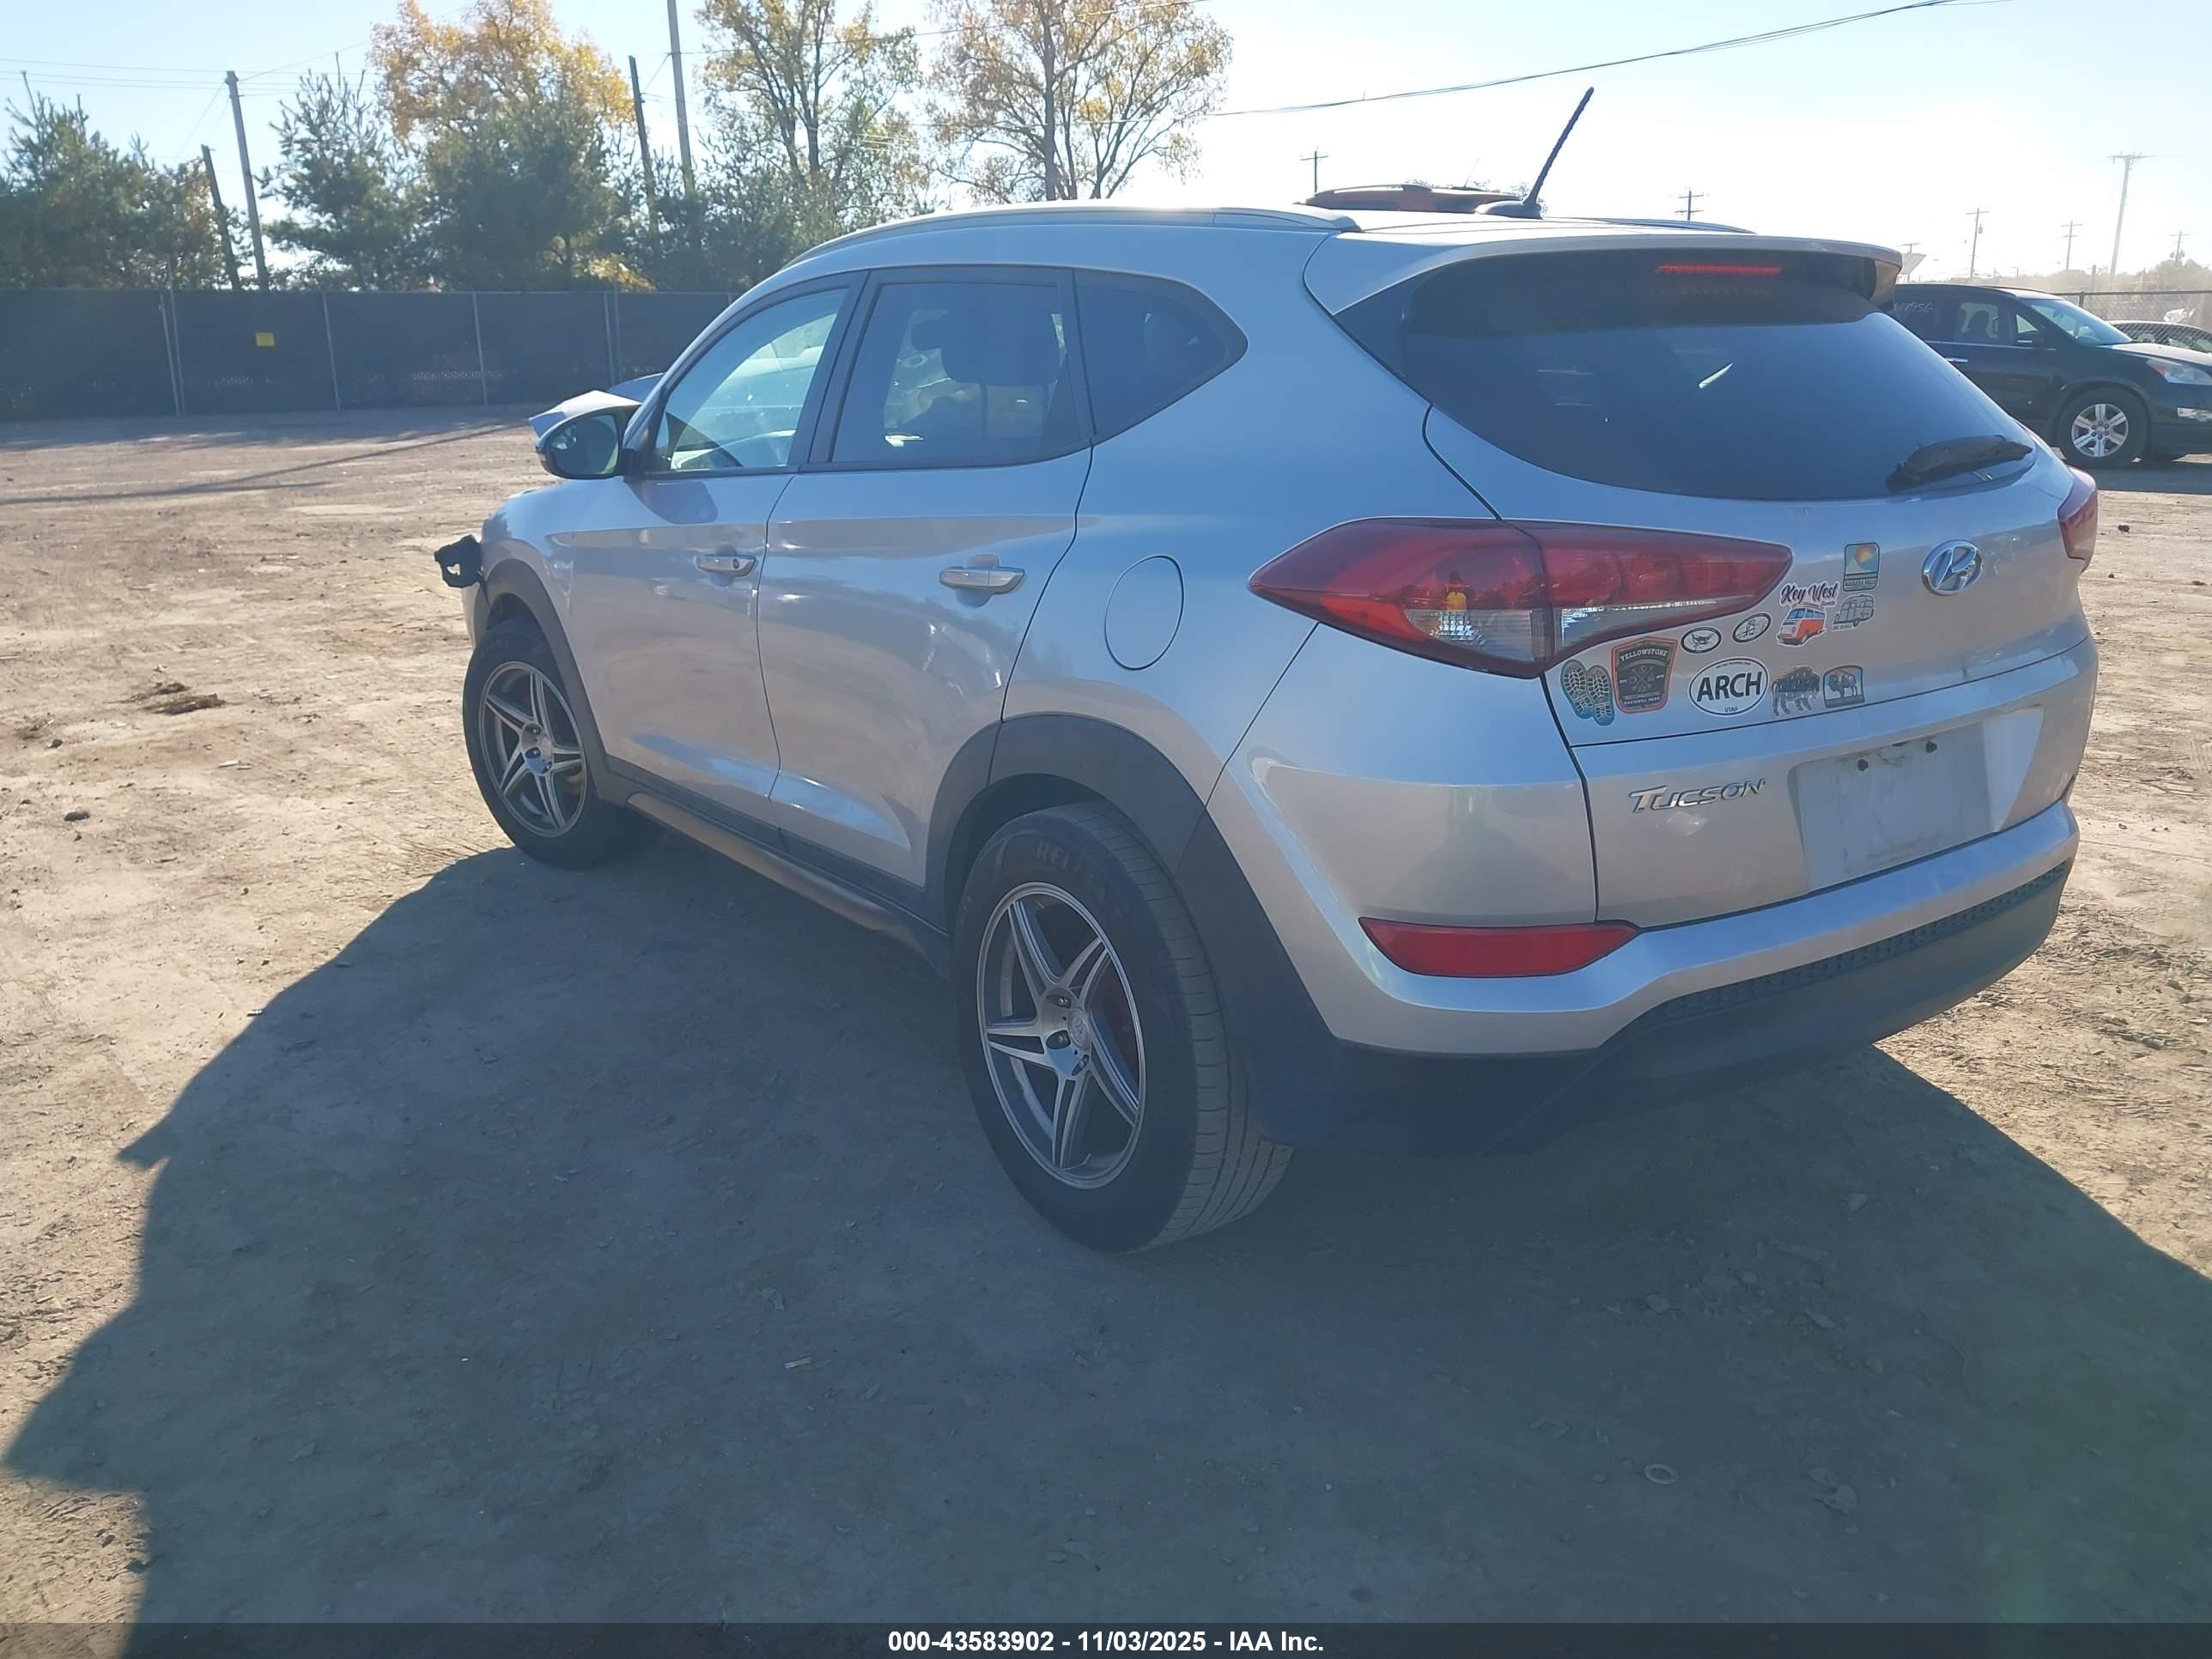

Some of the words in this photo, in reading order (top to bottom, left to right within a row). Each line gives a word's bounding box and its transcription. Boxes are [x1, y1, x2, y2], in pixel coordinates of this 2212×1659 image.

[1781, 584, 1807, 604] Key
[1808, 583, 1838, 601] West
[1620, 647, 1668, 662] YELLOWSTONE
[1697, 671, 1763, 702] ARCH
[1629, 776, 1766, 813] TUCSON
